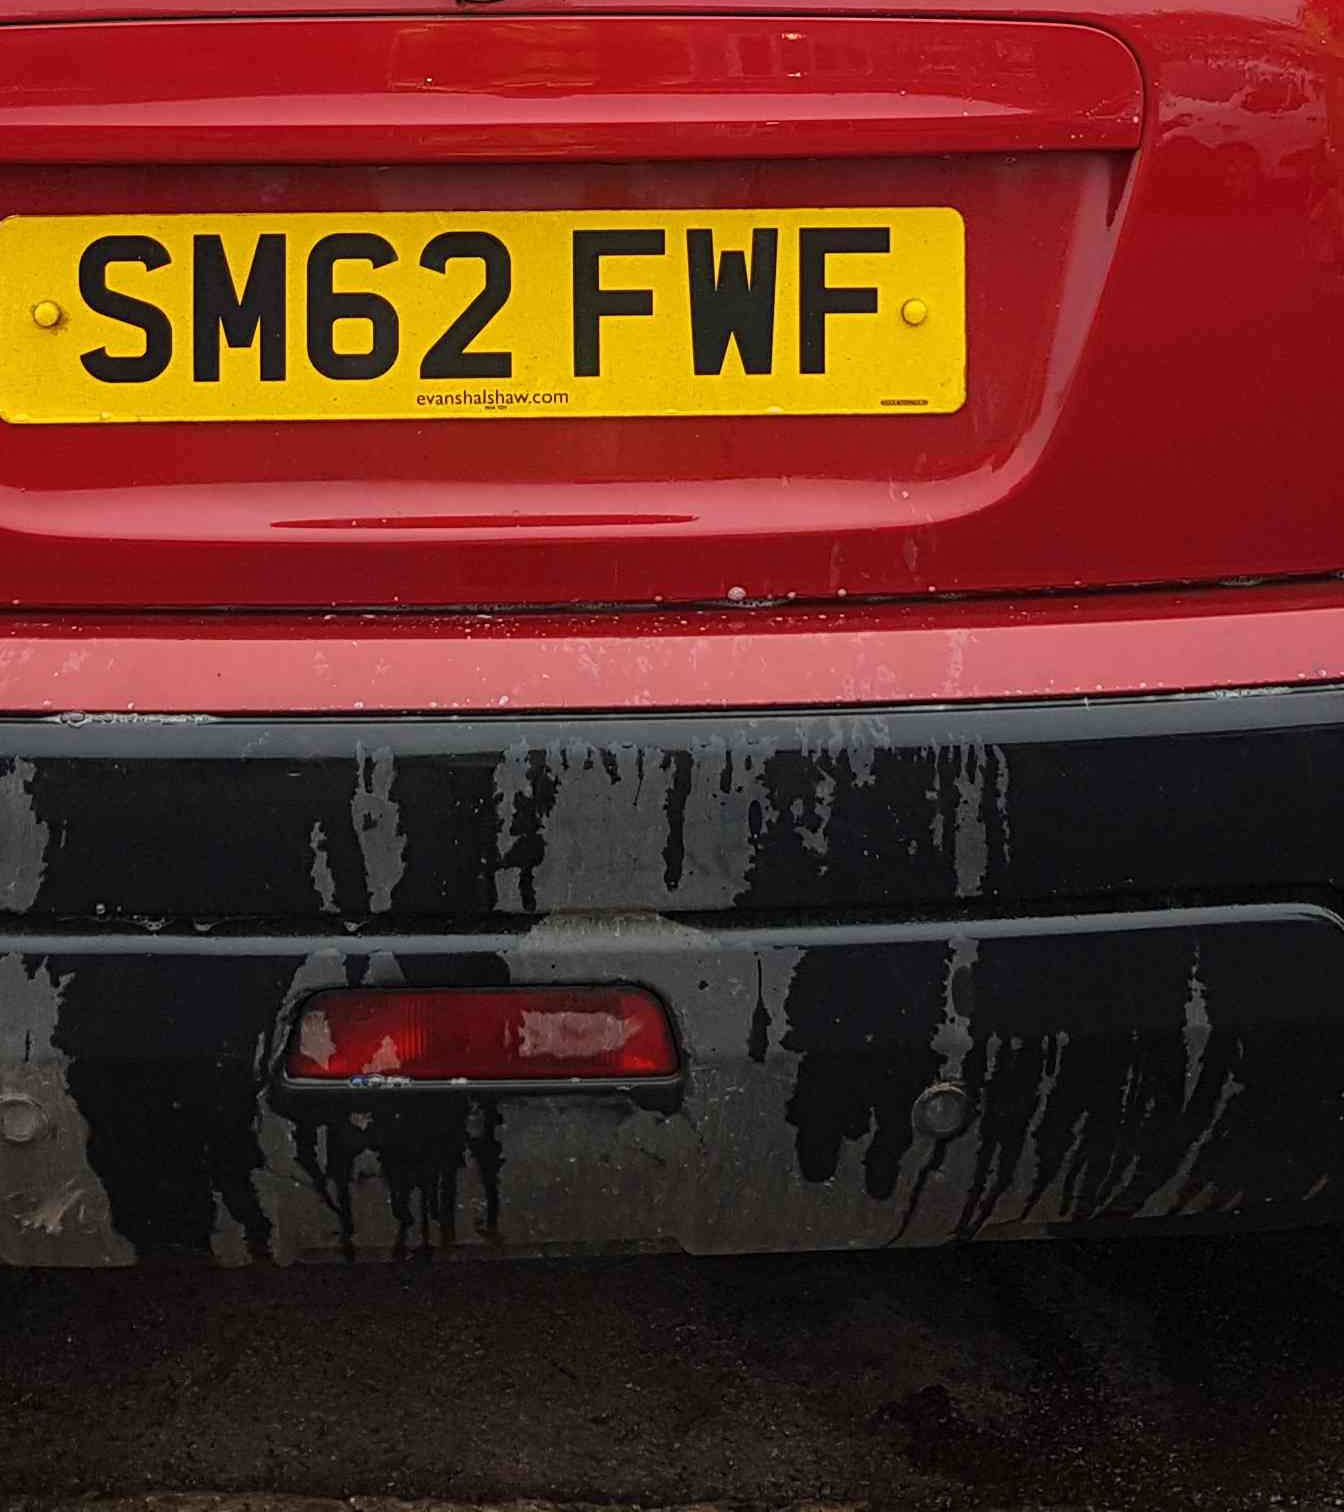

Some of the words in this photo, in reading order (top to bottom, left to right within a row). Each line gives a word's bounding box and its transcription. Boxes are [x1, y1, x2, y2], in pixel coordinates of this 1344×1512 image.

[77, 231, 514, 384] SM62
[571, 226, 892, 378] FWF
[416, 389, 569, 406] evanshalshaw.com
